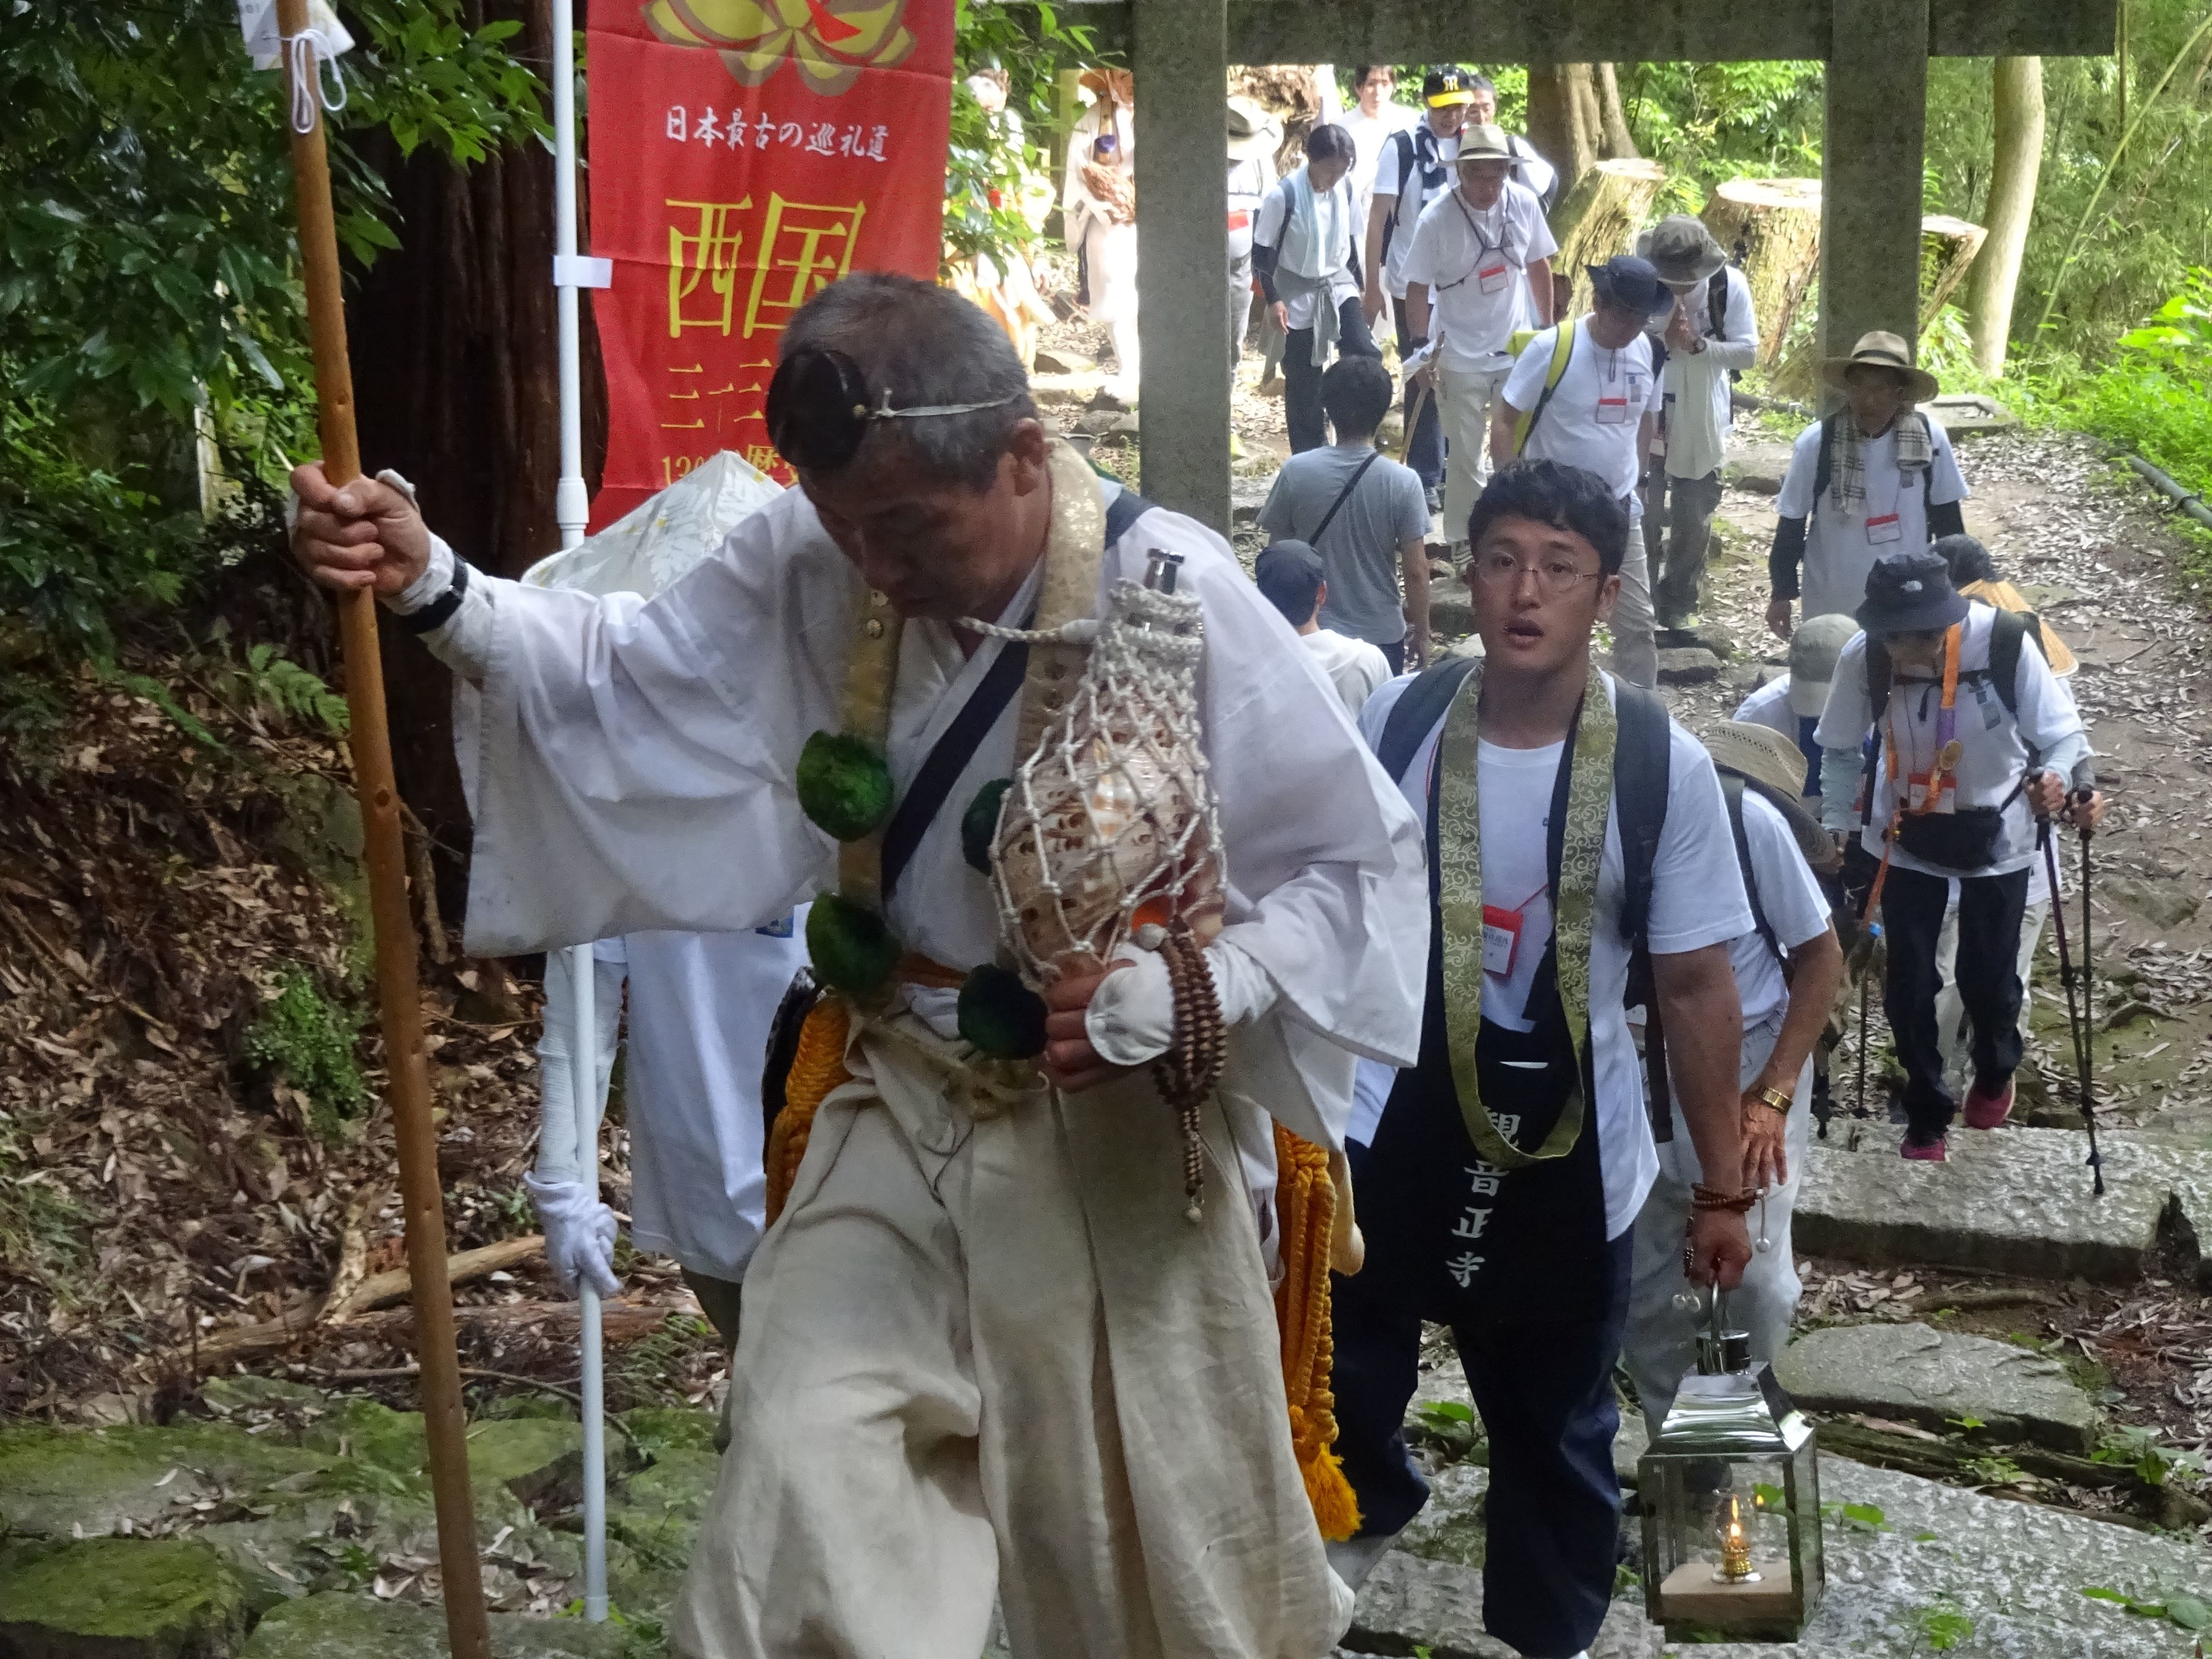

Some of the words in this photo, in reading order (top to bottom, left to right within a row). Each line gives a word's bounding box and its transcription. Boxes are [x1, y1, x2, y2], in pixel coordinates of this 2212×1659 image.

[666, 105, 889, 163] 日本最古の巡礼道
[665, 191, 867, 339] 西国
